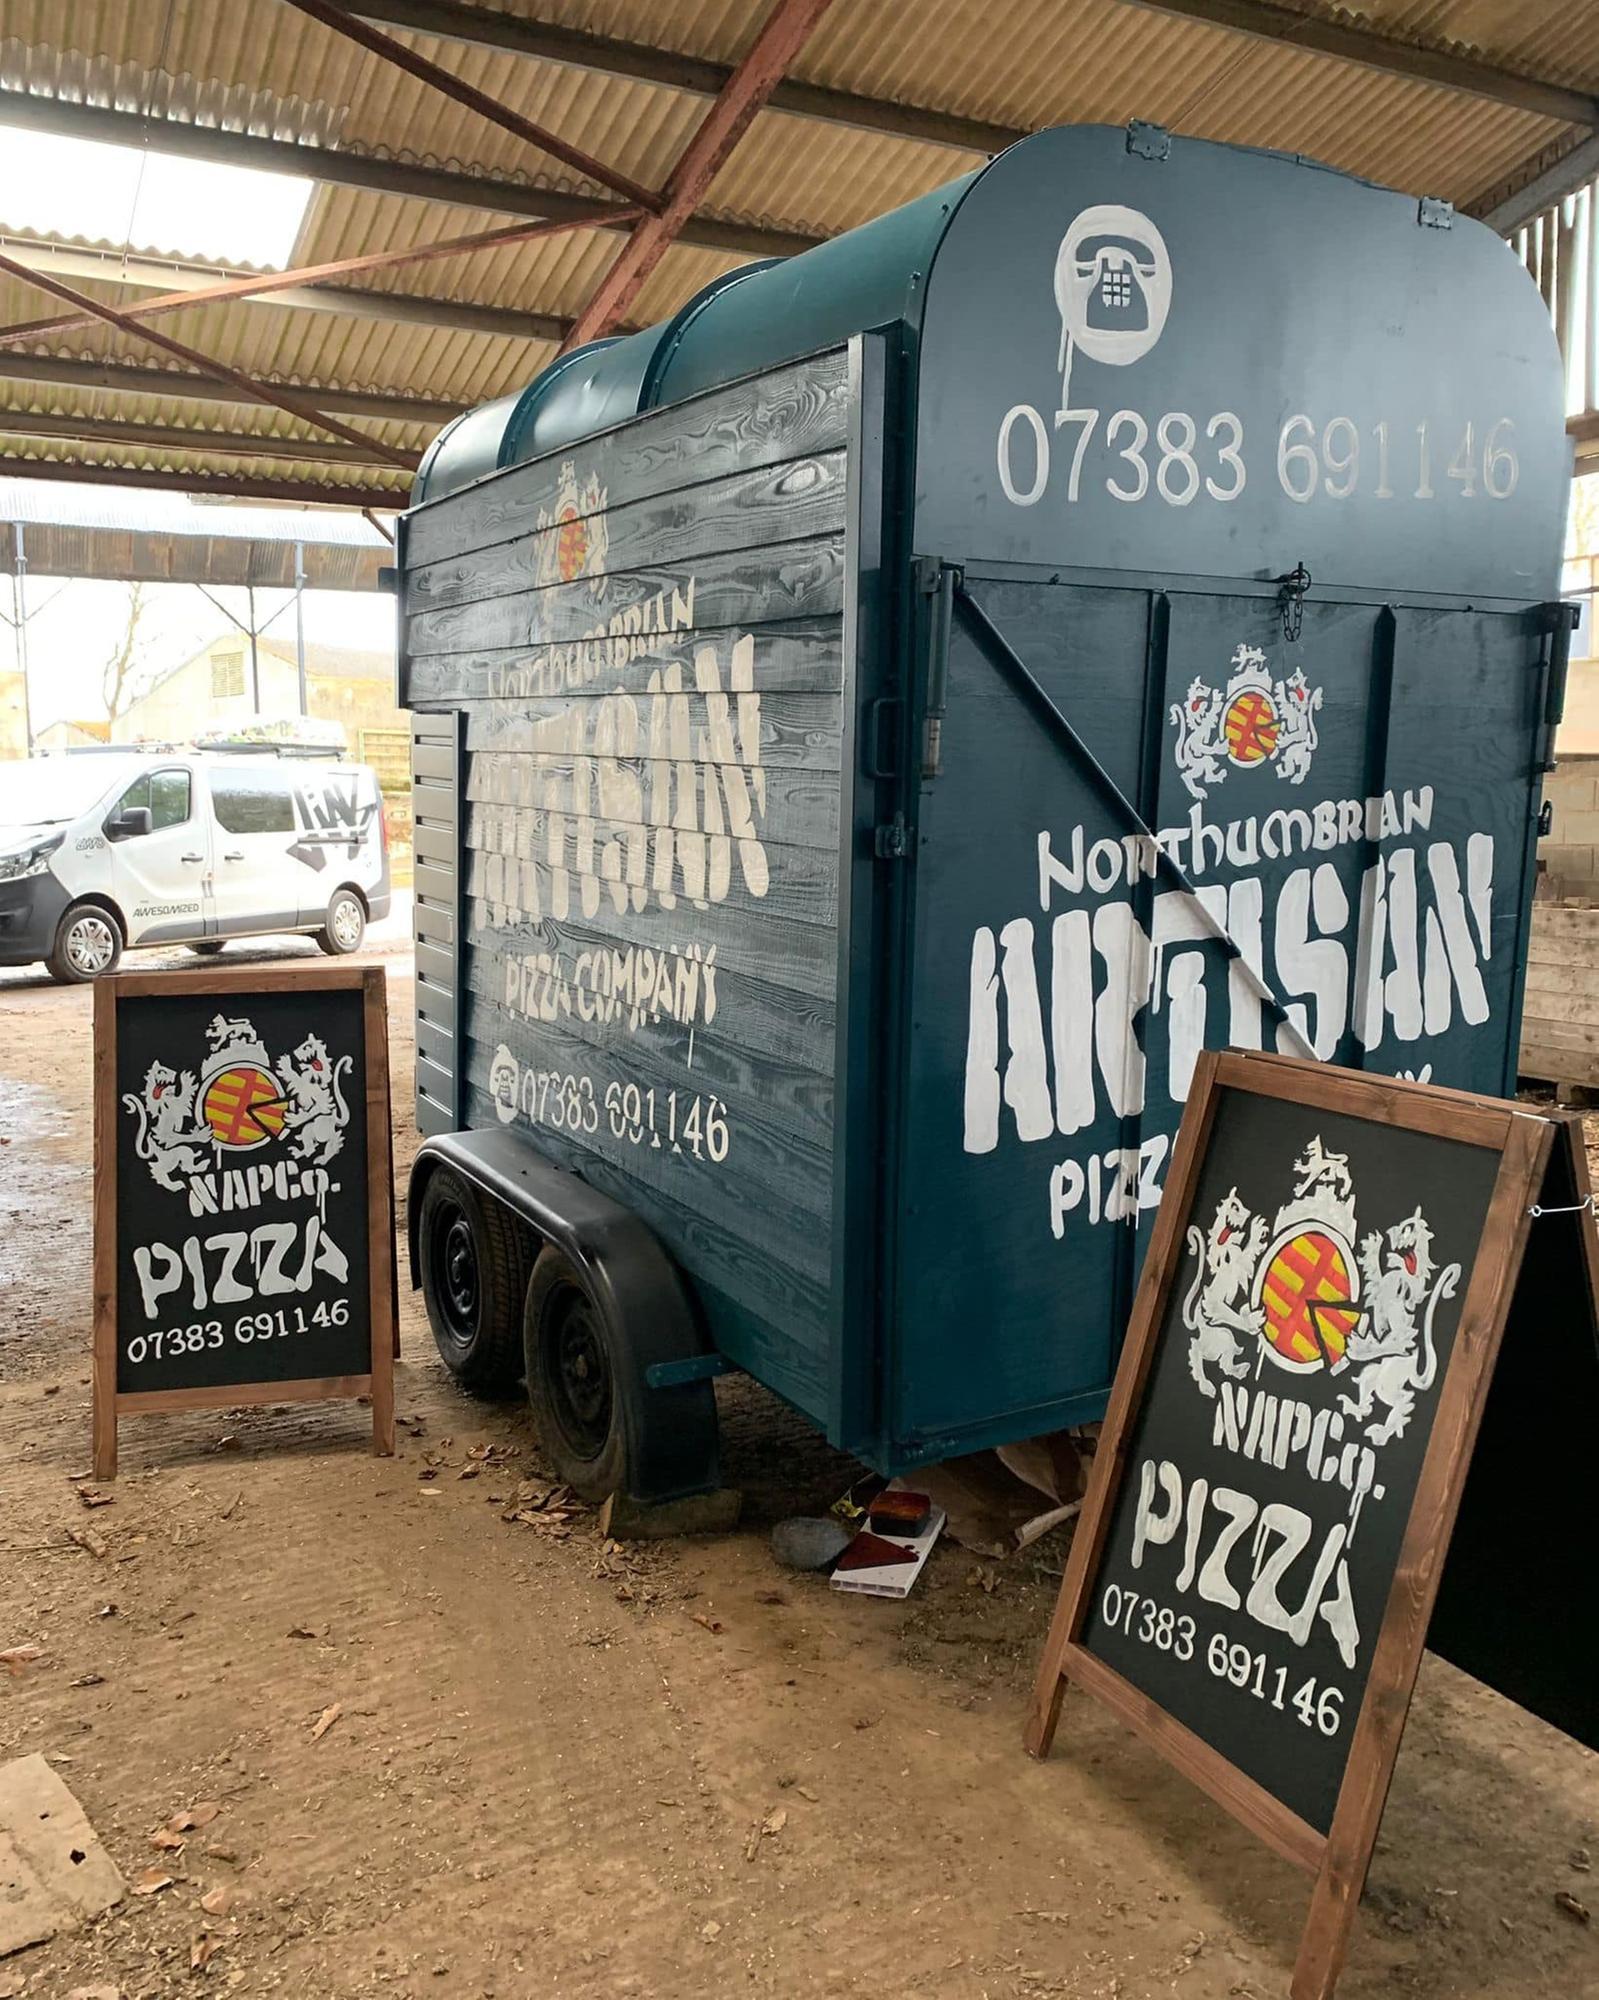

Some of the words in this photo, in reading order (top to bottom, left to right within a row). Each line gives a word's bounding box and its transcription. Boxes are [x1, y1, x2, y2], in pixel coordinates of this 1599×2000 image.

[997, 404, 1246, 506] 07383
[1277, 414, 1519, 504] 691146
[132, 904, 199, 918] AWESOMIZED
[505, 951, 571, 1021] PIZZA
[573, 943, 717, 1031] COMPANY
[964, 832, 1494, 1153] ARTISAN
[521, 1068, 598, 1134] 07383
[605, 1081, 730, 1162] 691146
[1049, 1128, 1181, 1240] PIZZ
[132, 1215, 350, 1319] PIZZA
[127, 1321, 225, 1363] 07383
[234, 1299, 350, 1344] 691146
[1130, 1458, 1358, 1669] PIZZA
[1102, 1583, 1196, 1662] 07383
[1207, 1632, 1343, 1737] 691146
